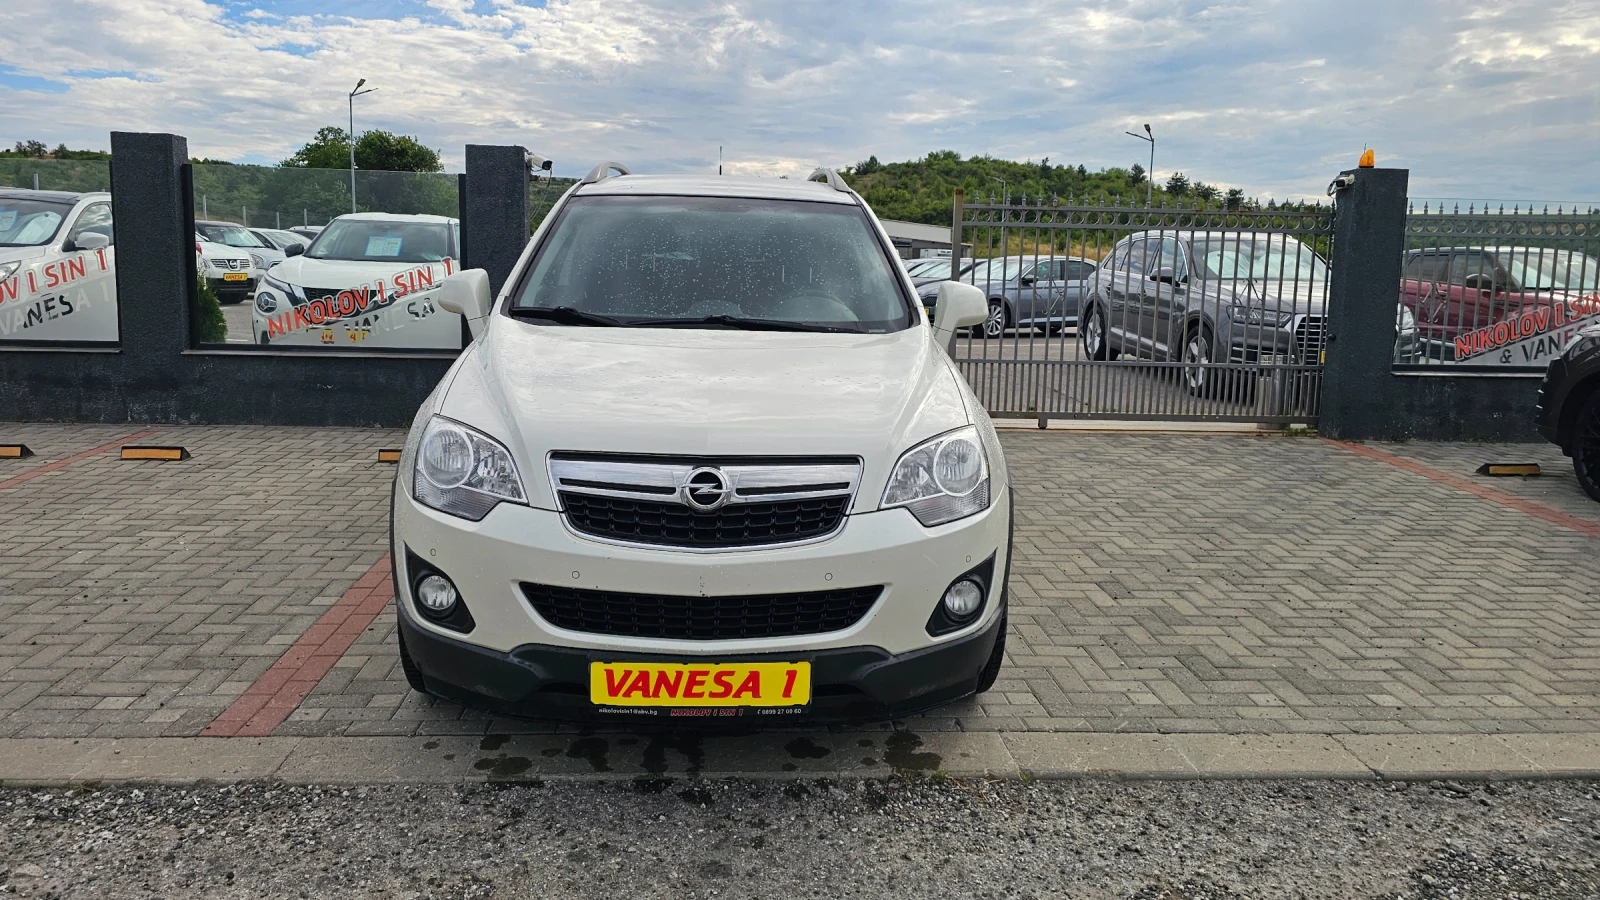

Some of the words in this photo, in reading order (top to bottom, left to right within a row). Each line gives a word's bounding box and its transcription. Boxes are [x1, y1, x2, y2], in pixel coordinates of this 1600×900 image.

[44, 255, 86, 288] SIN
[96, 249, 107, 271] 1
[267, 284, 370, 339] NIKOLOV
[394, 265, 434, 297] SIN
[1456, 307, 1550, 359] NIKOLOV
[1500, 348, 1513, 364] &
[604, 669, 762, 699] VANESA
[782, 670, 797, 699] 1
[670, 709, 712, 717] NIKOLOV
[719, 709, 736, 717] SIN
